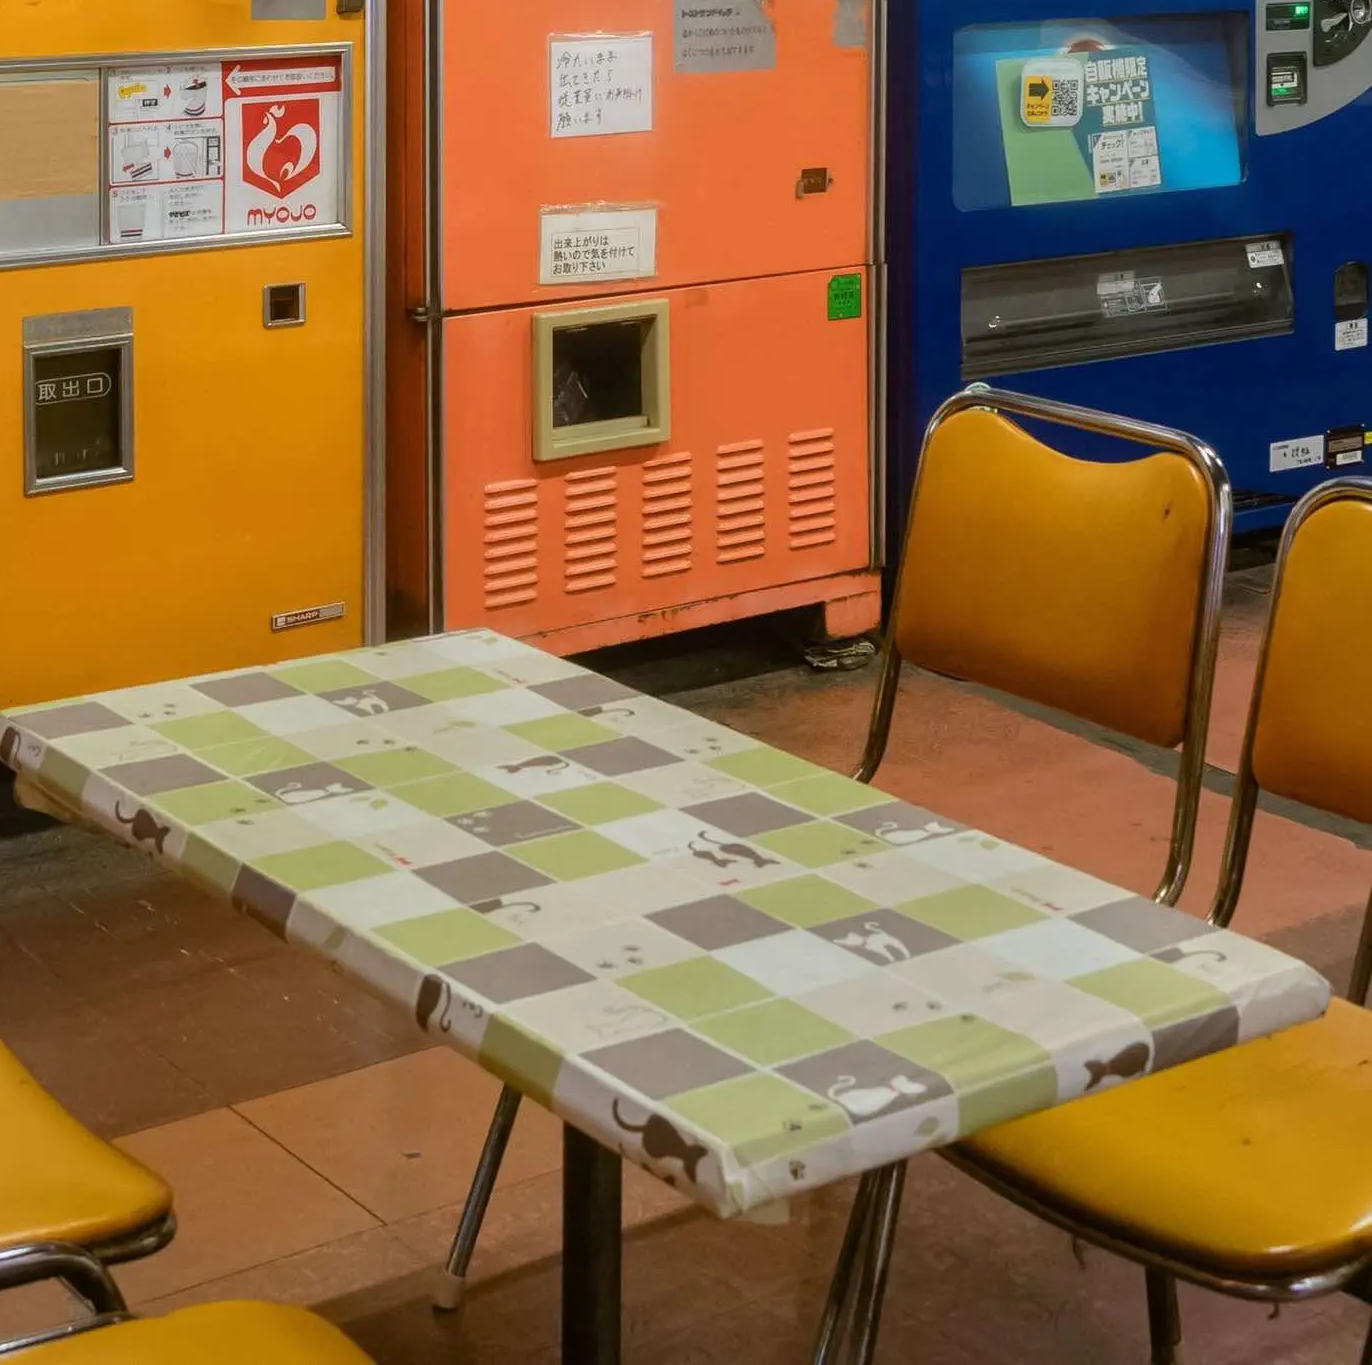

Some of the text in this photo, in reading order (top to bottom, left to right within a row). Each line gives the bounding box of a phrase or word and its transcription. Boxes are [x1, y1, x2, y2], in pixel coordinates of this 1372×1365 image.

[247, 203, 317, 226] MYOJO
[553, 235, 610, 250] 出来上がりは
[553, 245, 636, 262] 熱いので気を付けて
[552, 260, 606, 275] お取り下さい
[38, 377, 104, 401] 取出口
